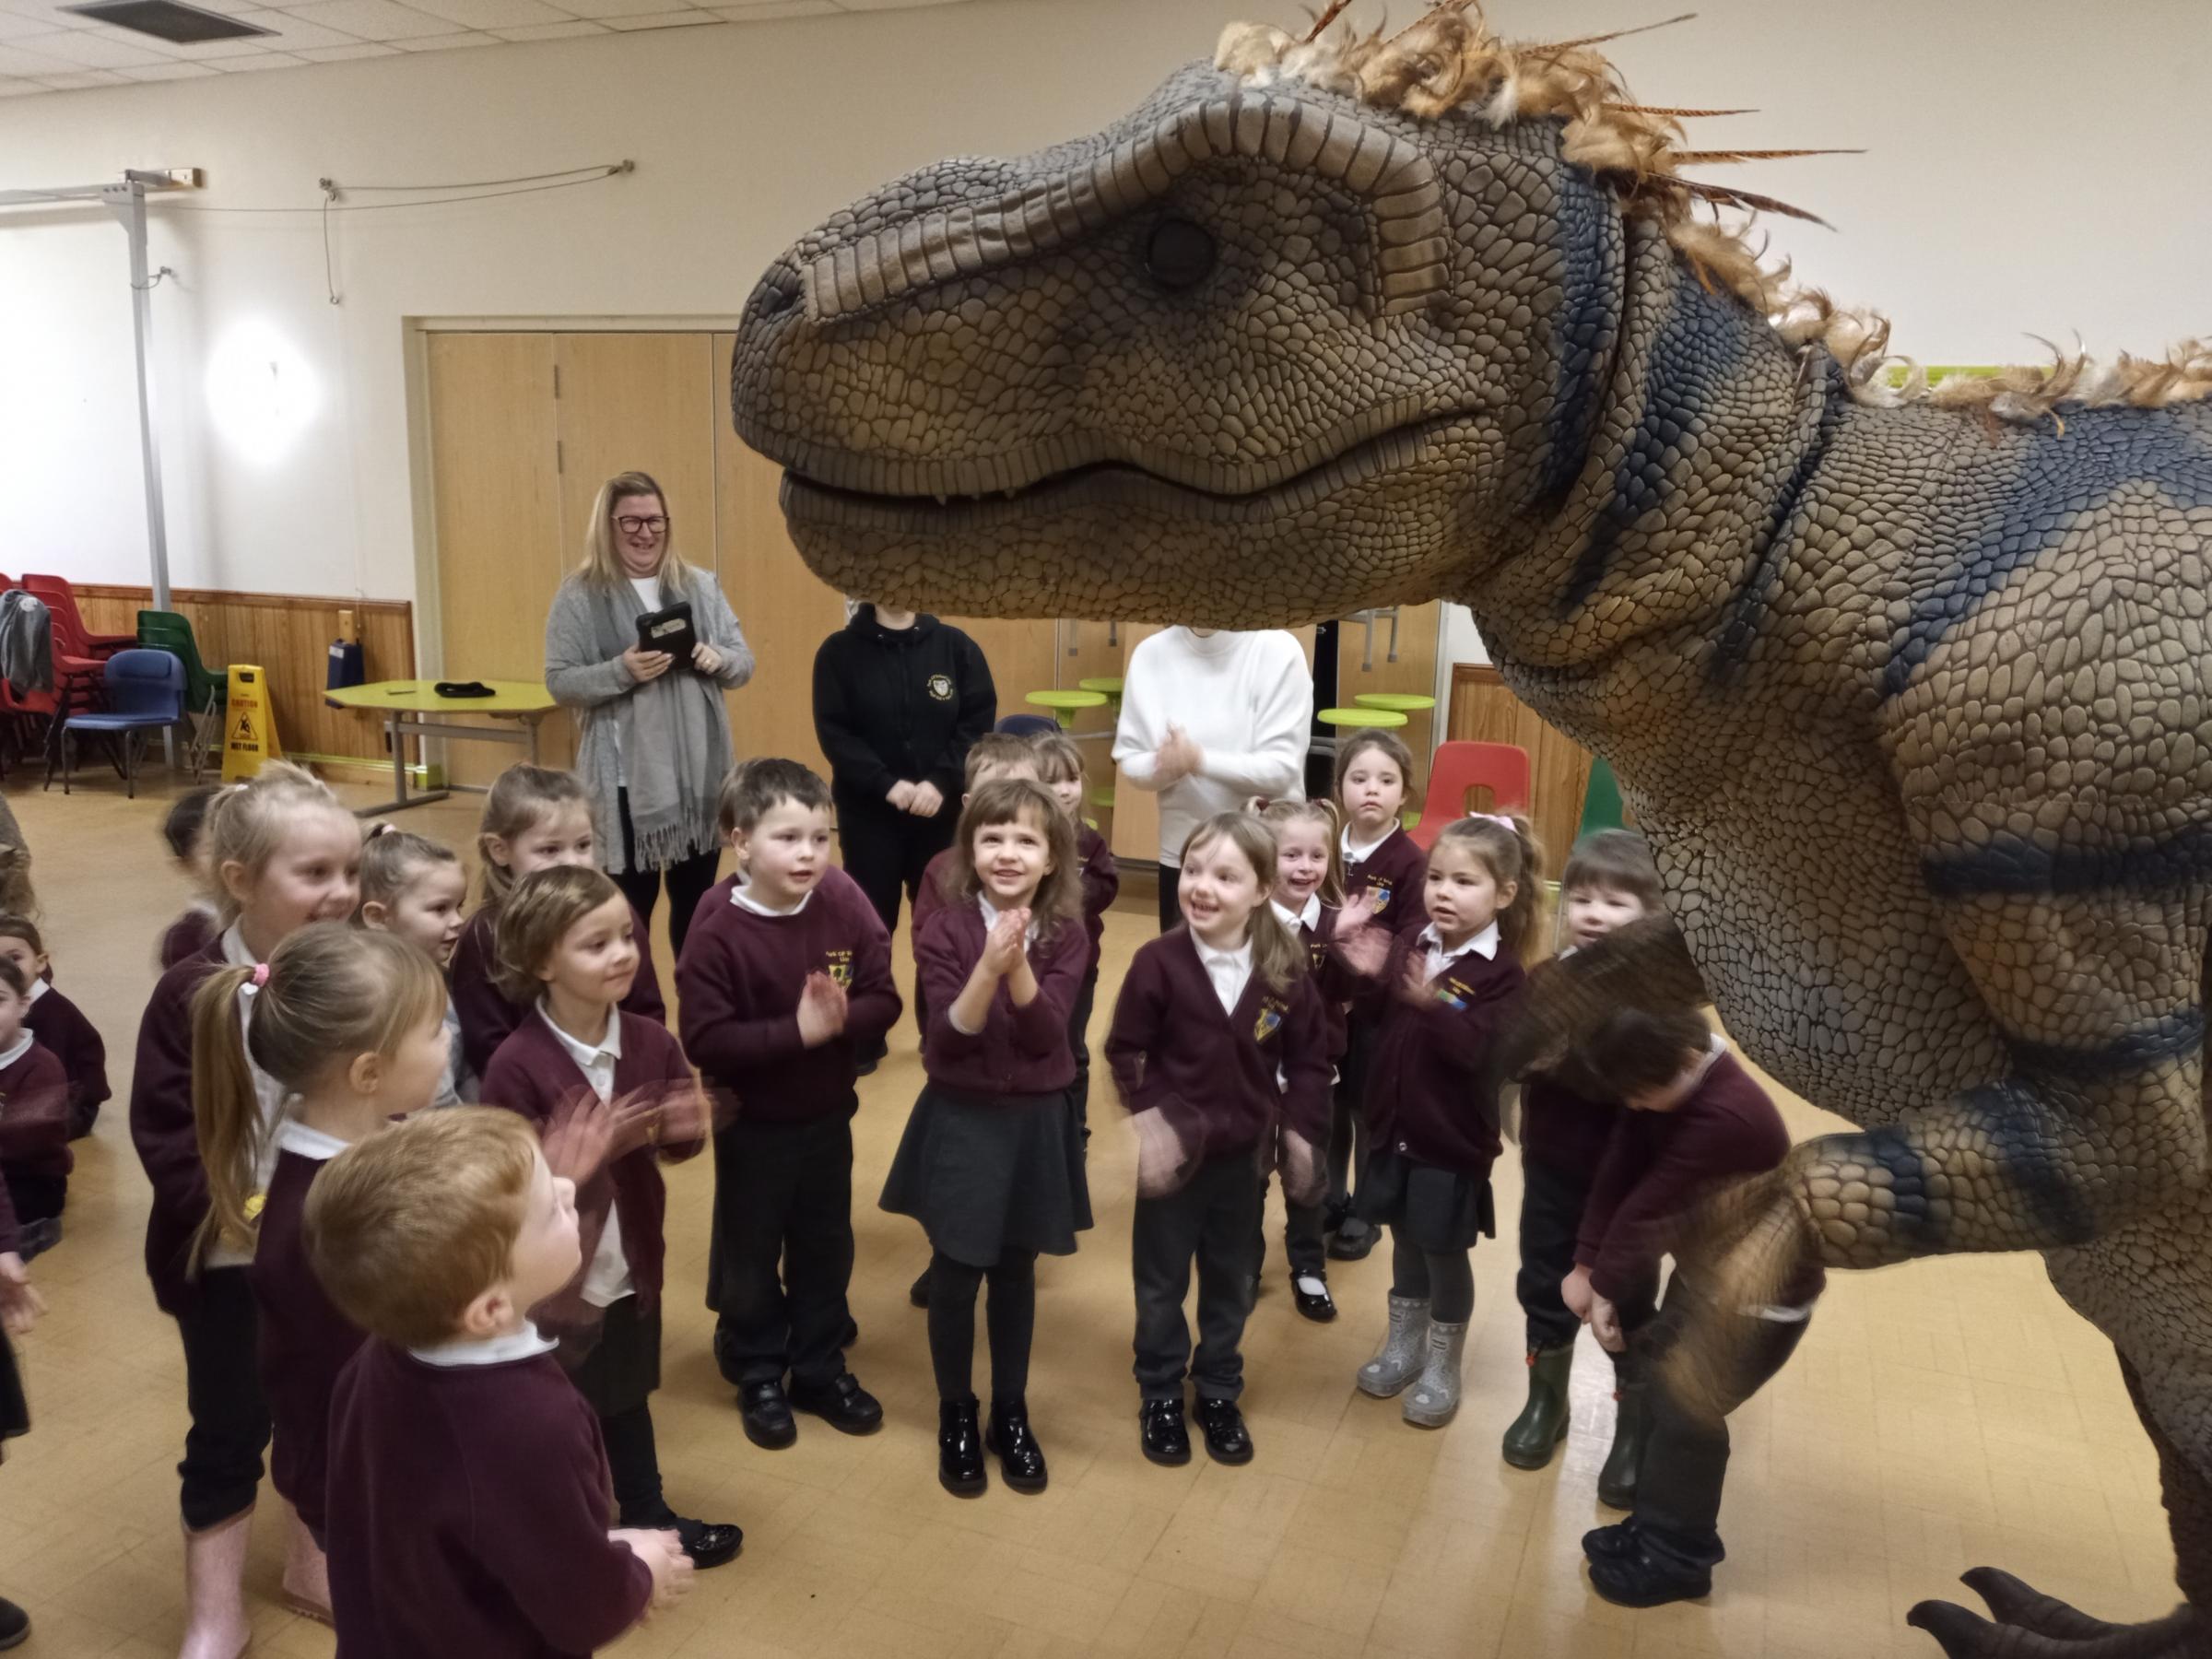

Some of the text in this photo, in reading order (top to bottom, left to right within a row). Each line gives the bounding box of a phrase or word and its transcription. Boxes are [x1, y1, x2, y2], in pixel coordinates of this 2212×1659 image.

[231, 699, 258, 708] CAUTION
[230, 742, 259, 752] WET FLOOR
